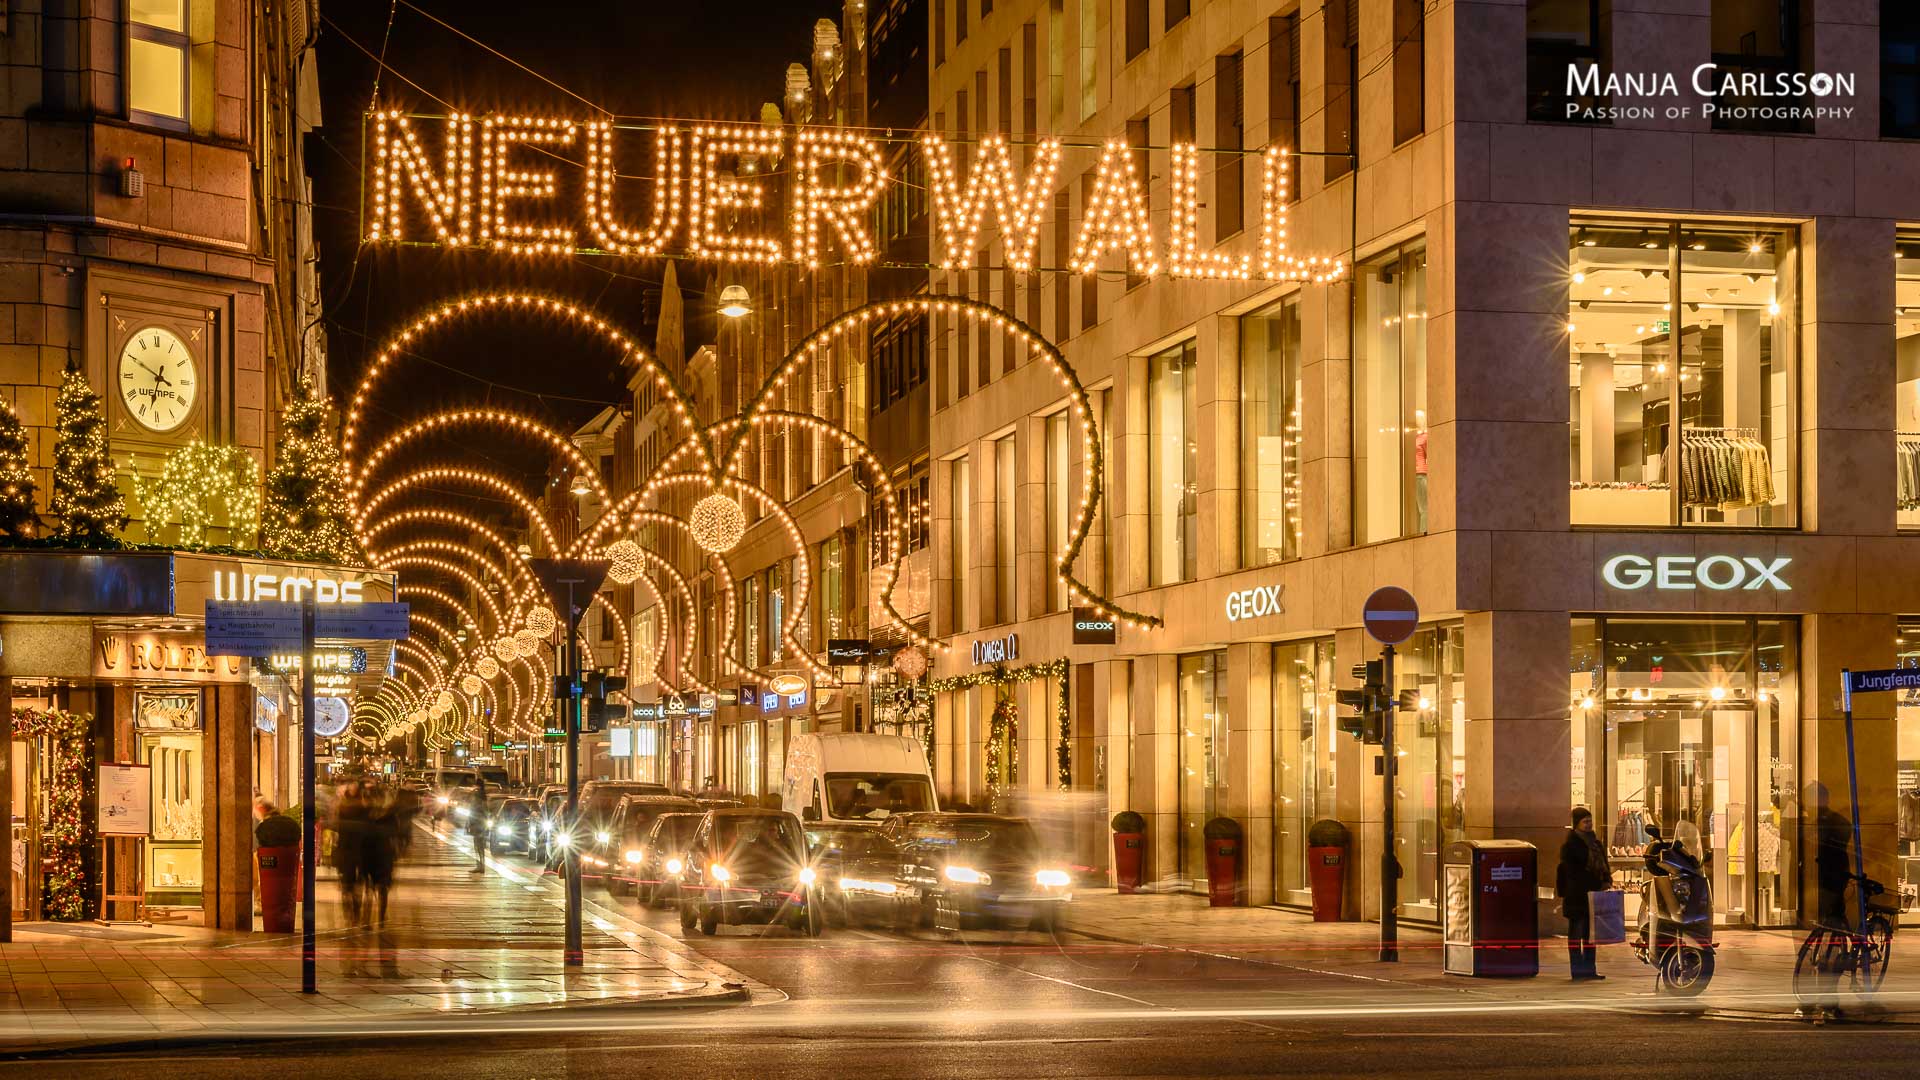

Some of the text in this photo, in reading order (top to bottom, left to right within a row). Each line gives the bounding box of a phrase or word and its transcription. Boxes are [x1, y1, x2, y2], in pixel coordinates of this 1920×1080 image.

[369, 109, 1346, 283] NEUER WALL
[139, 388, 175, 398] WEMPE
[1602, 555, 1793, 590] GEOX
[1226, 585, 1284, 622] GEOX
[1075, 622, 1113, 630] GEOX
[131, 641, 215, 673] ROLEX
[981, 639, 1005, 664] OMEGA
[633, 708, 655, 716] ecco
